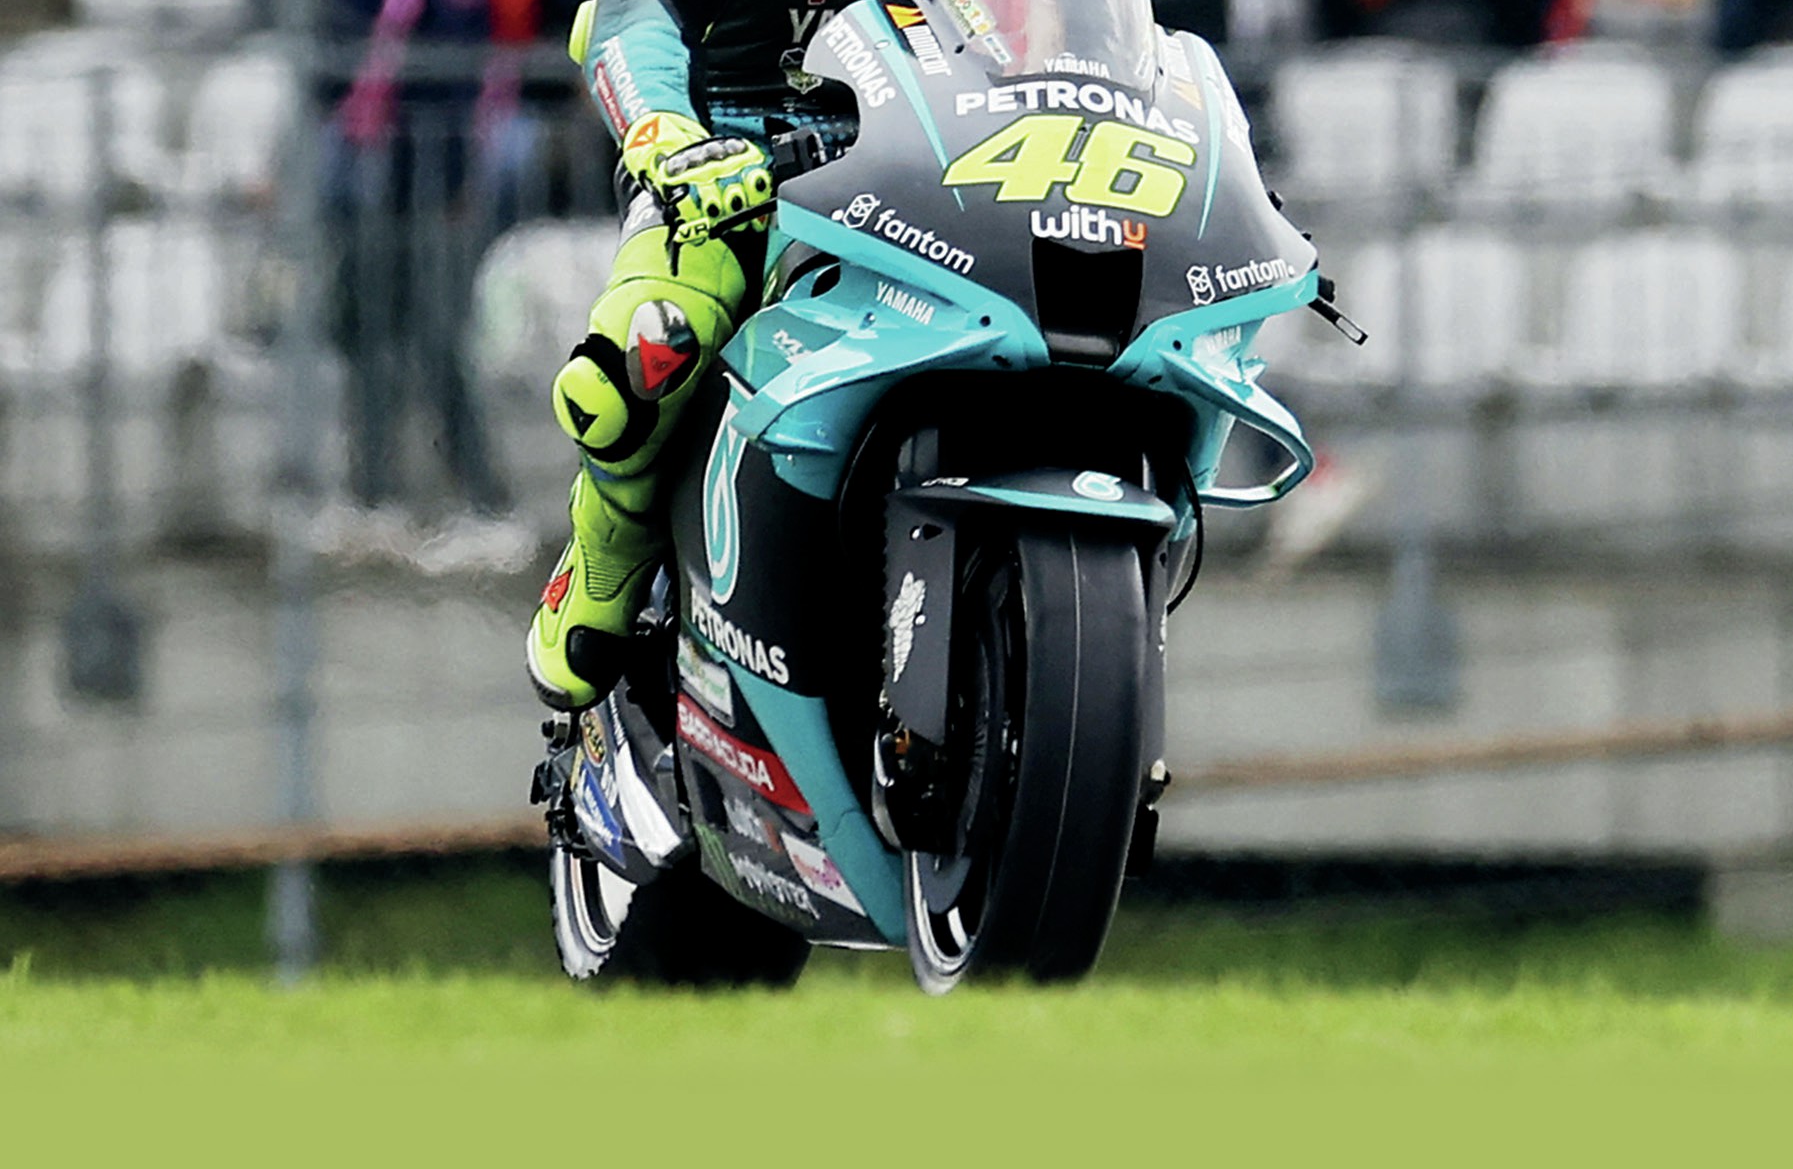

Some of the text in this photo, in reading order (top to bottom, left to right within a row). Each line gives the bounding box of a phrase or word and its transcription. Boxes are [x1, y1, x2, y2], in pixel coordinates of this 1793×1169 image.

[820, 14, 896, 108] PETRONAS
[1044, 59, 1111, 80] YAMAHA
[955, 79, 1200, 144] PETRONAS
[941, 114, 1198, 218] 46
[873, 208, 976, 275] fantom
[875, 281, 936, 326] YAMAHA
[1214, 258, 1289, 293] fantom
[690, 587, 790, 686] PETRONAS
